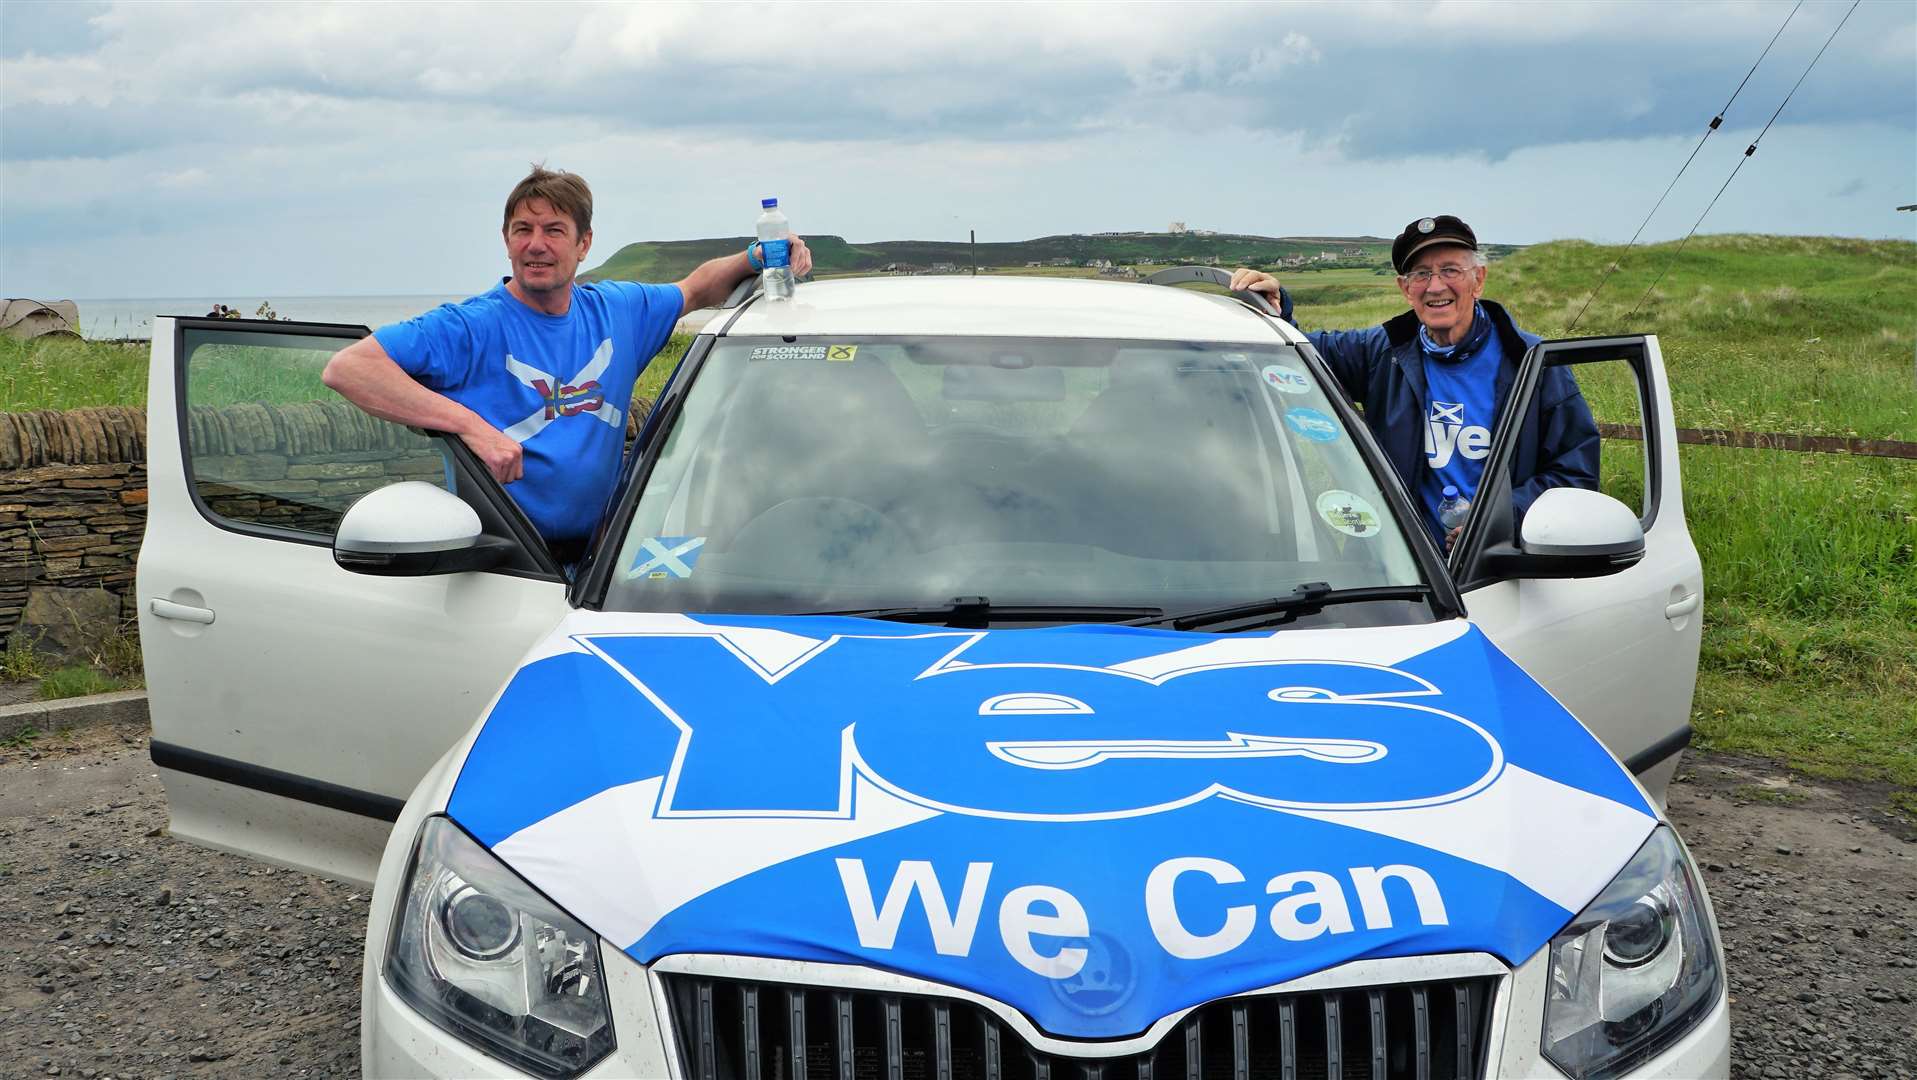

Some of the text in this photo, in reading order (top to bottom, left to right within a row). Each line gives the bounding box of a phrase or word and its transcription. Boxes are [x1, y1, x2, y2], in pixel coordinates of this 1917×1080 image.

[752, 346, 827, 354] STRONGER
[1268, 371, 1308, 386] AYE
[570, 631, 1504, 822] Yes
[834, 856, 1449, 980] We Can
